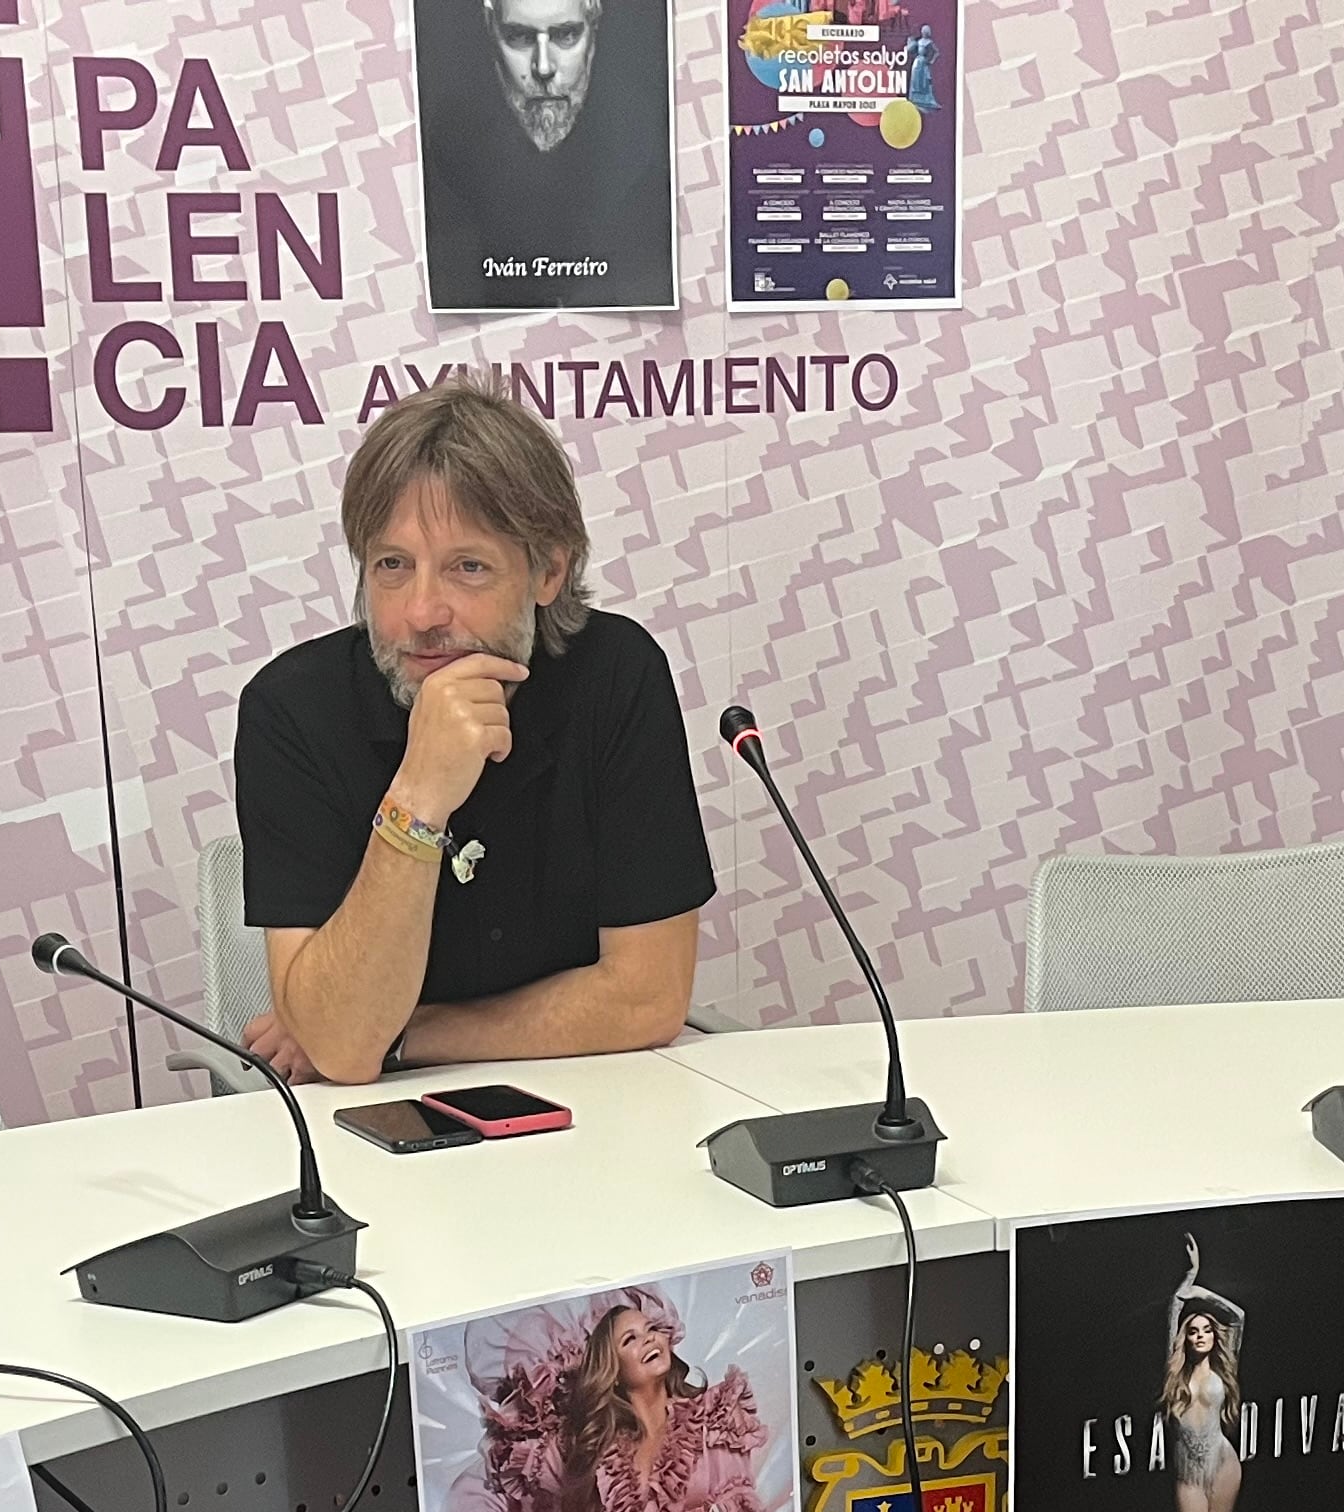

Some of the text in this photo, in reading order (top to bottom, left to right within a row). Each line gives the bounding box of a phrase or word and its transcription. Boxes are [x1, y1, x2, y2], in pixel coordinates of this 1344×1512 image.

[73, 57, 251, 171] PA
[779, 68, 813, 93] SAN
[85, 192, 343, 302] LEN
[483, 257, 608, 277] Iván Ferreiro
[93, 320, 325, 431] CIA
[1083, 1411, 1166, 1479] ESA
